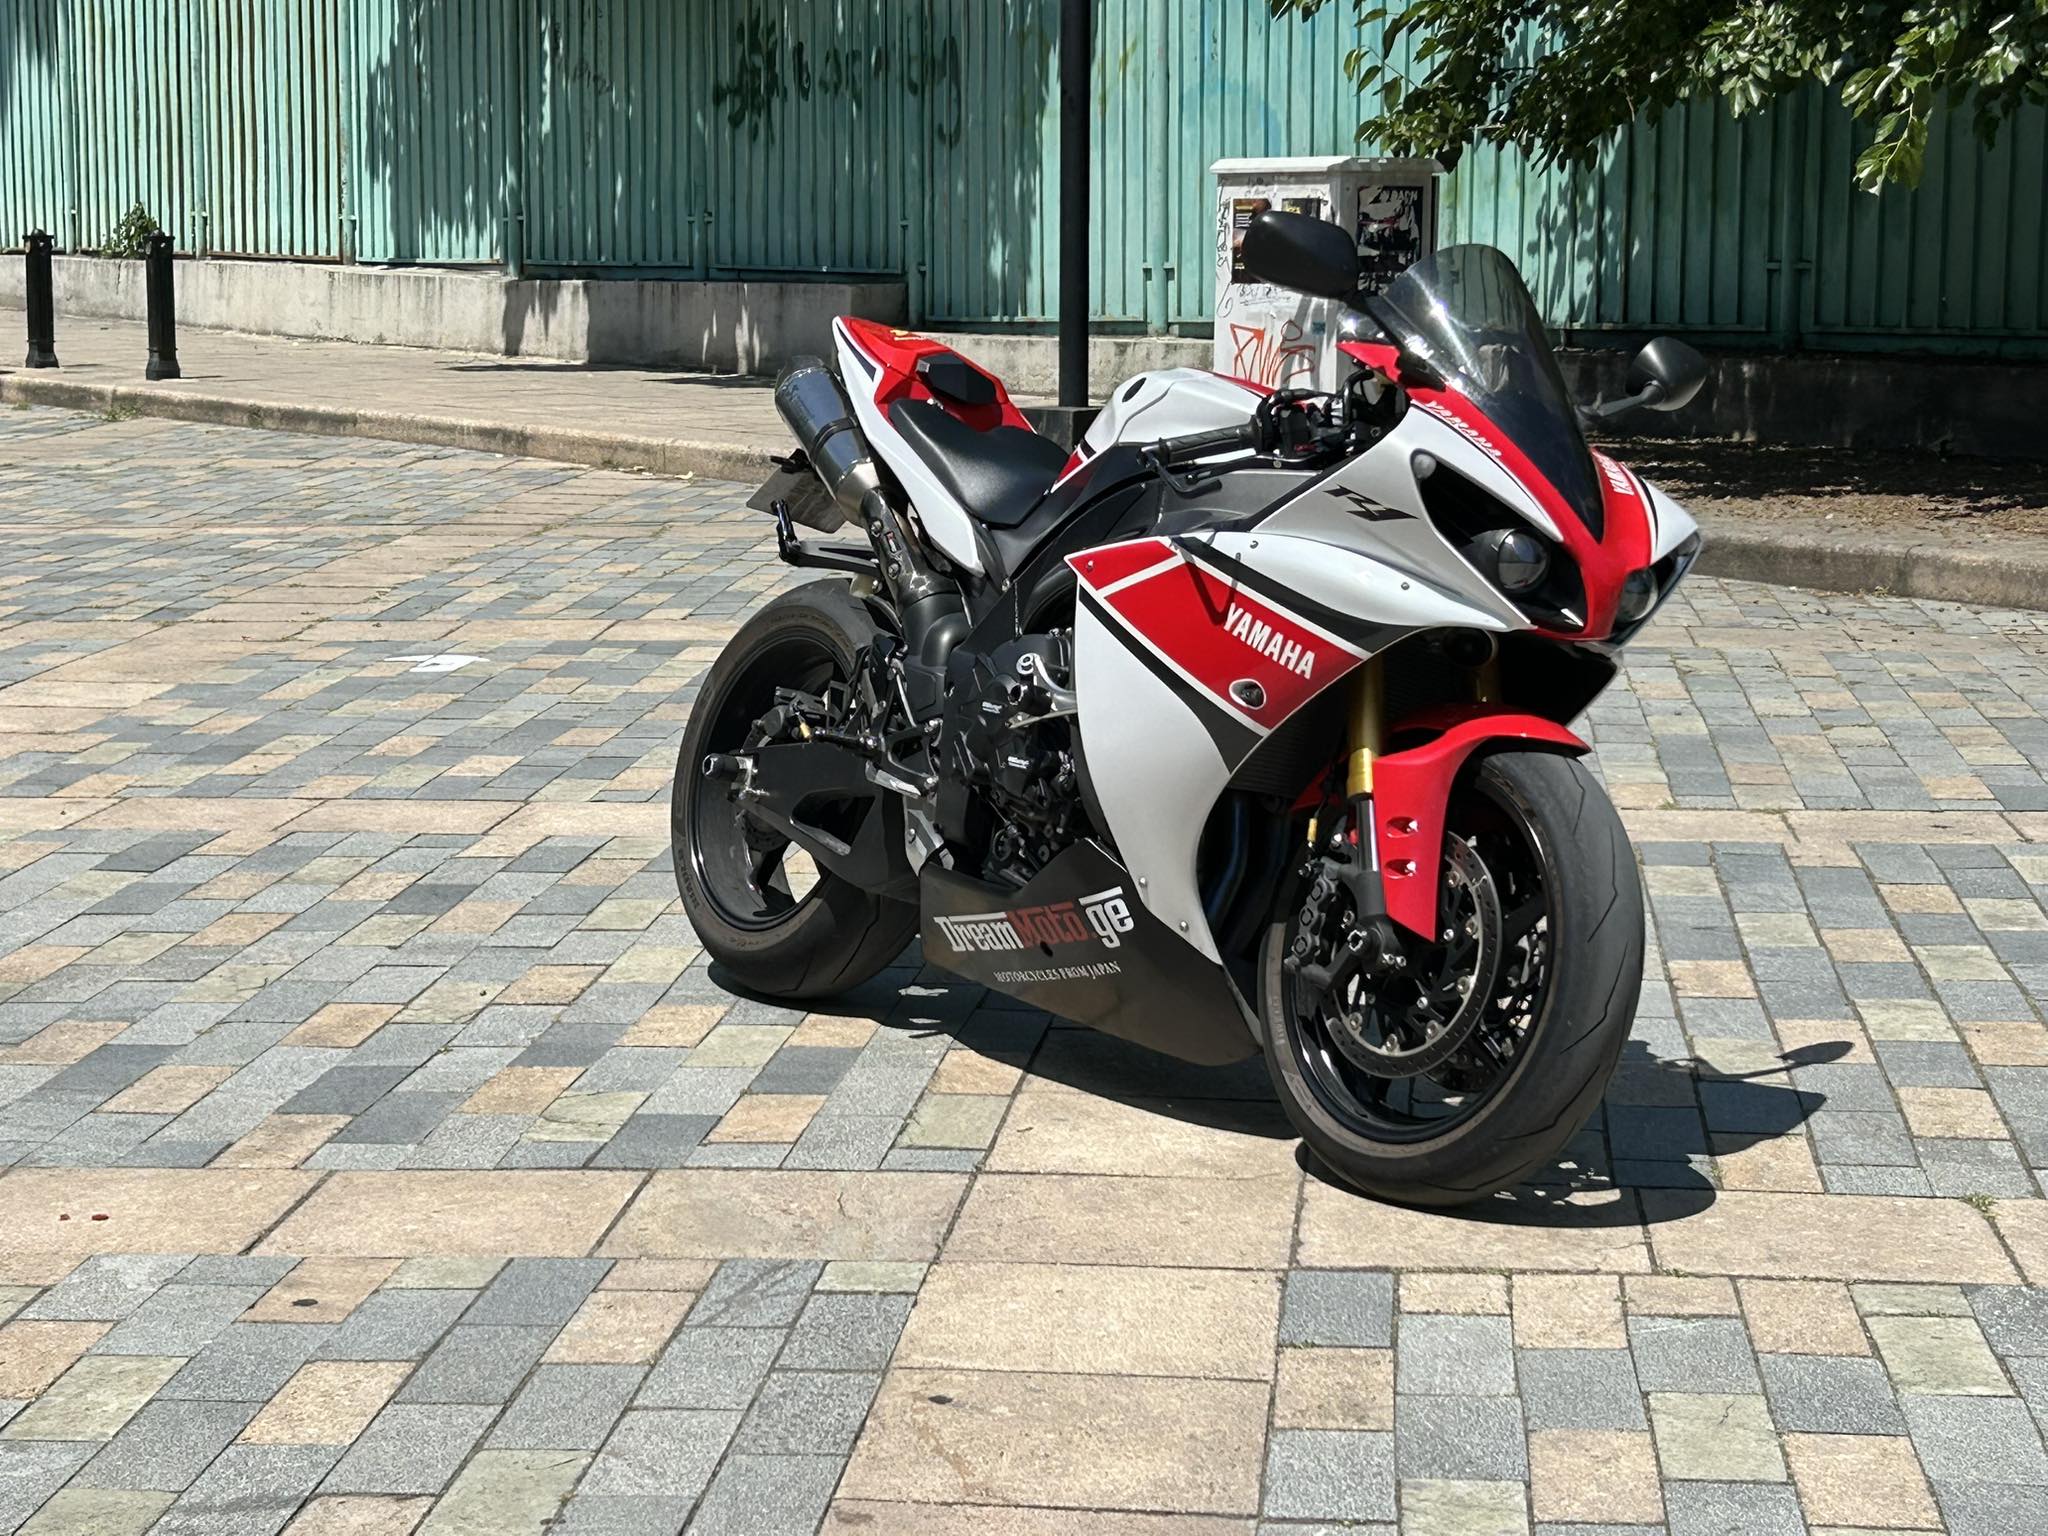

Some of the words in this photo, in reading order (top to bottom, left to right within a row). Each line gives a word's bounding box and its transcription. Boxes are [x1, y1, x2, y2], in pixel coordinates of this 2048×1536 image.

[1222, 602, 1316, 680] YAMAHA
[994, 968, 1059, 983] MOTORCYCLES
[1060, 965, 1087, 981] FROM
[1087, 960, 1122, 980] JAPAN
